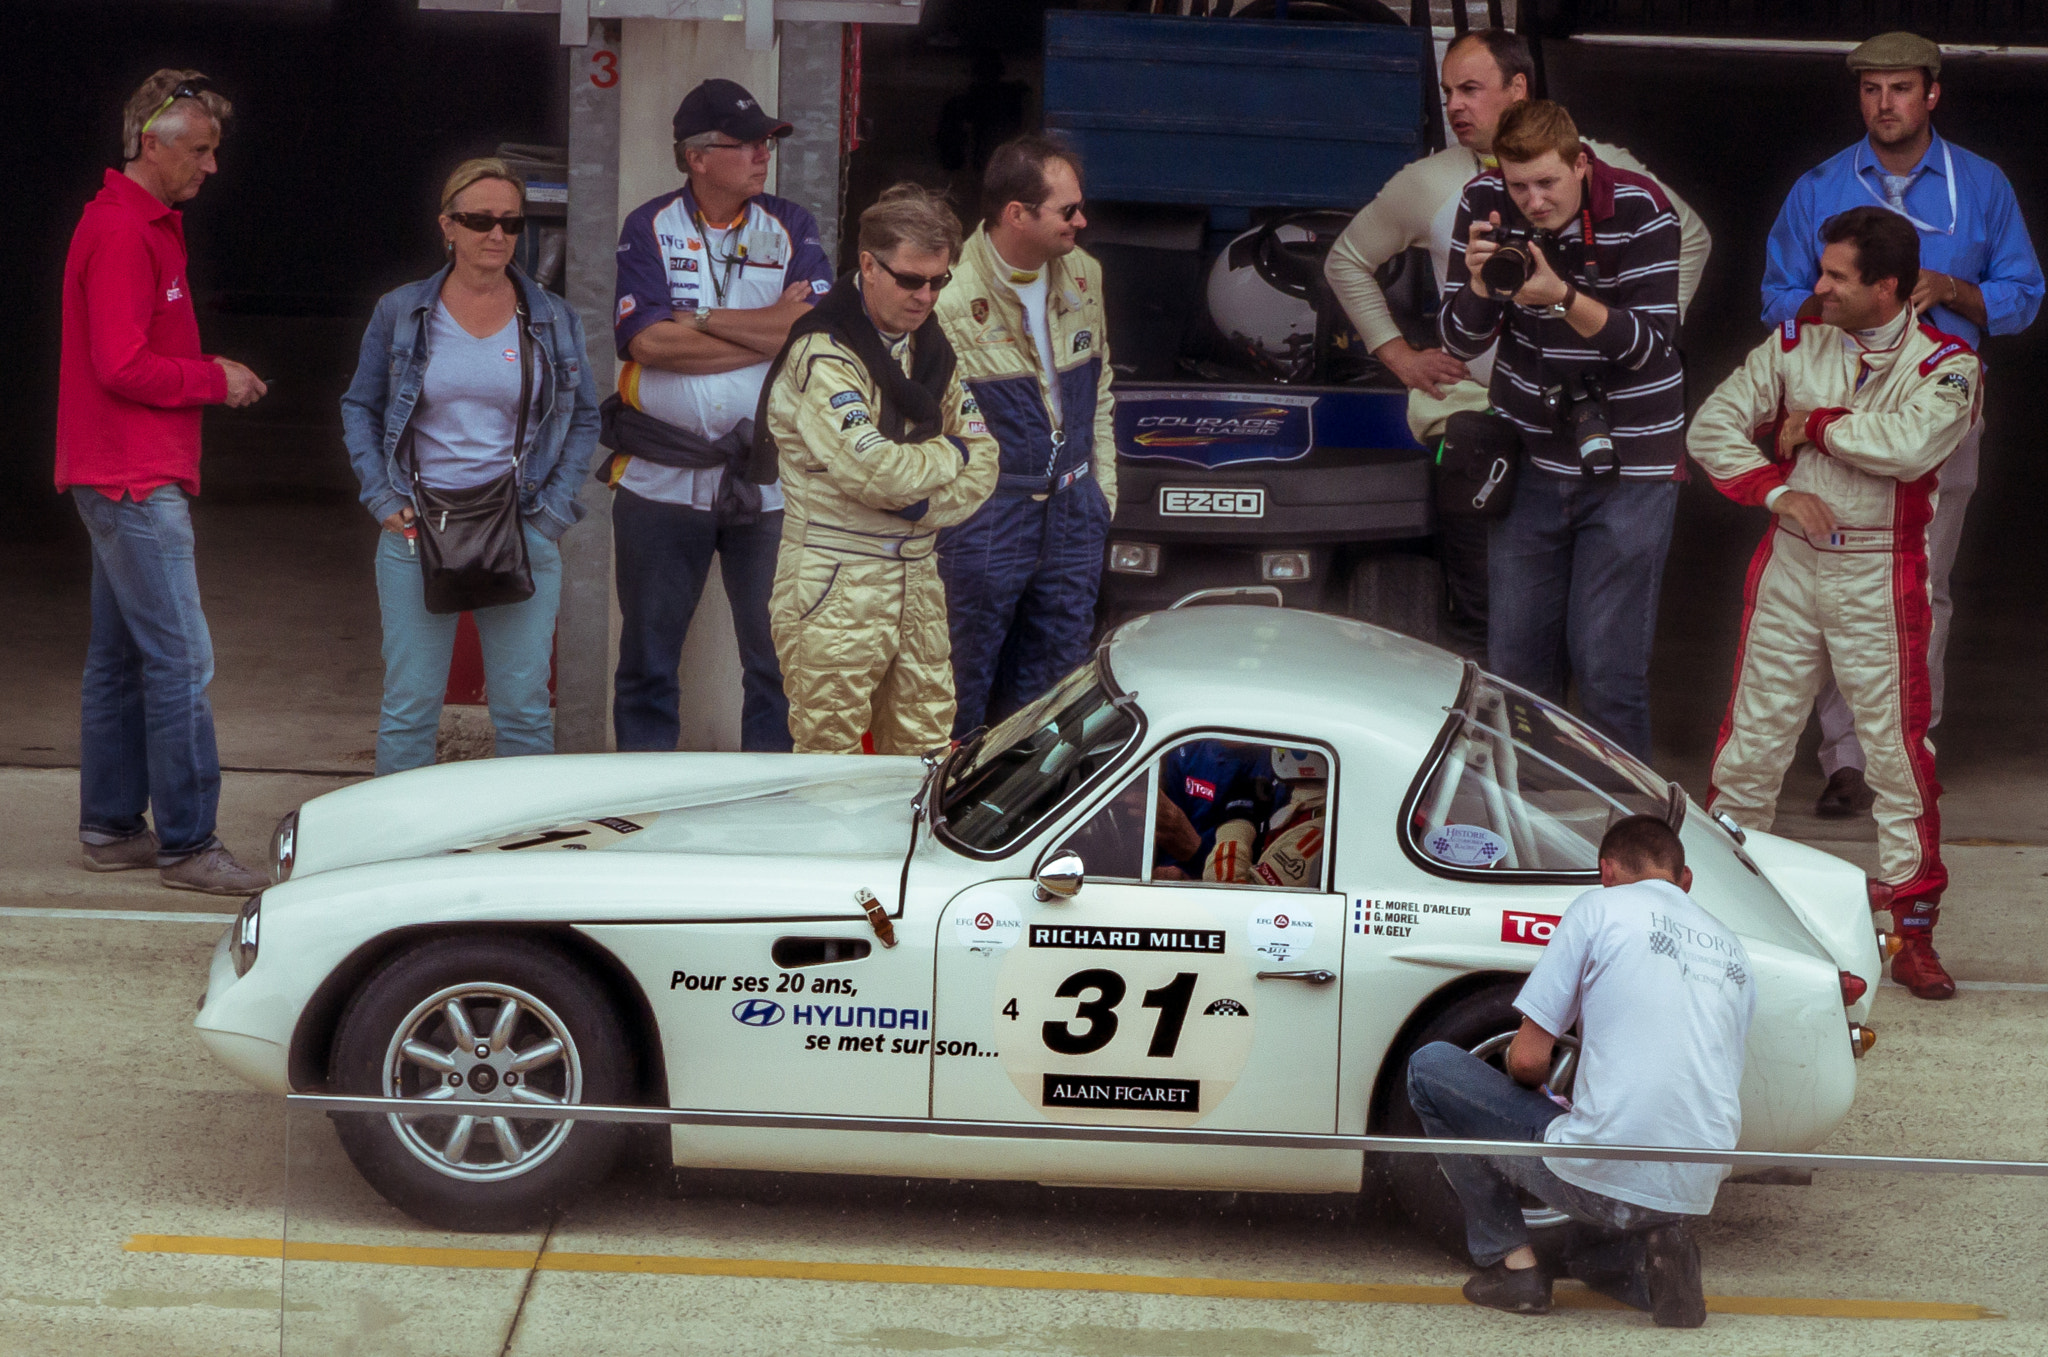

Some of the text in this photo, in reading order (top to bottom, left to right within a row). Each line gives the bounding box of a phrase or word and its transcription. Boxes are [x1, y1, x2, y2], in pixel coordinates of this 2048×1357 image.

[590, 50, 619, 89] 3
[659, 234, 685, 250] ING
[670, 258, 687, 270] elf
[1137, 416, 1285, 428] COURAGE
[1195, 426, 1280, 436] CLASSIC
[1423, 903, 1471, 916] D'ARLEUX
[956, 918, 1021, 928] EFG BANK
[1291, 920, 1313, 928] BANK
[1508, 915, 1556, 940] TO
[1035, 929, 1221, 949] RICHARD MILLE
[670, 971, 858, 997] Pour ses 20 ans,
[793, 1004, 928, 1030] HYUNDAI
[1002, 998, 1020, 1021] 4
[1042, 968, 1199, 1058] 31
[805, 1033, 1000, 1057] se met sur son...
[1053, 1084, 1190, 1103] ALAIN FIGARET
